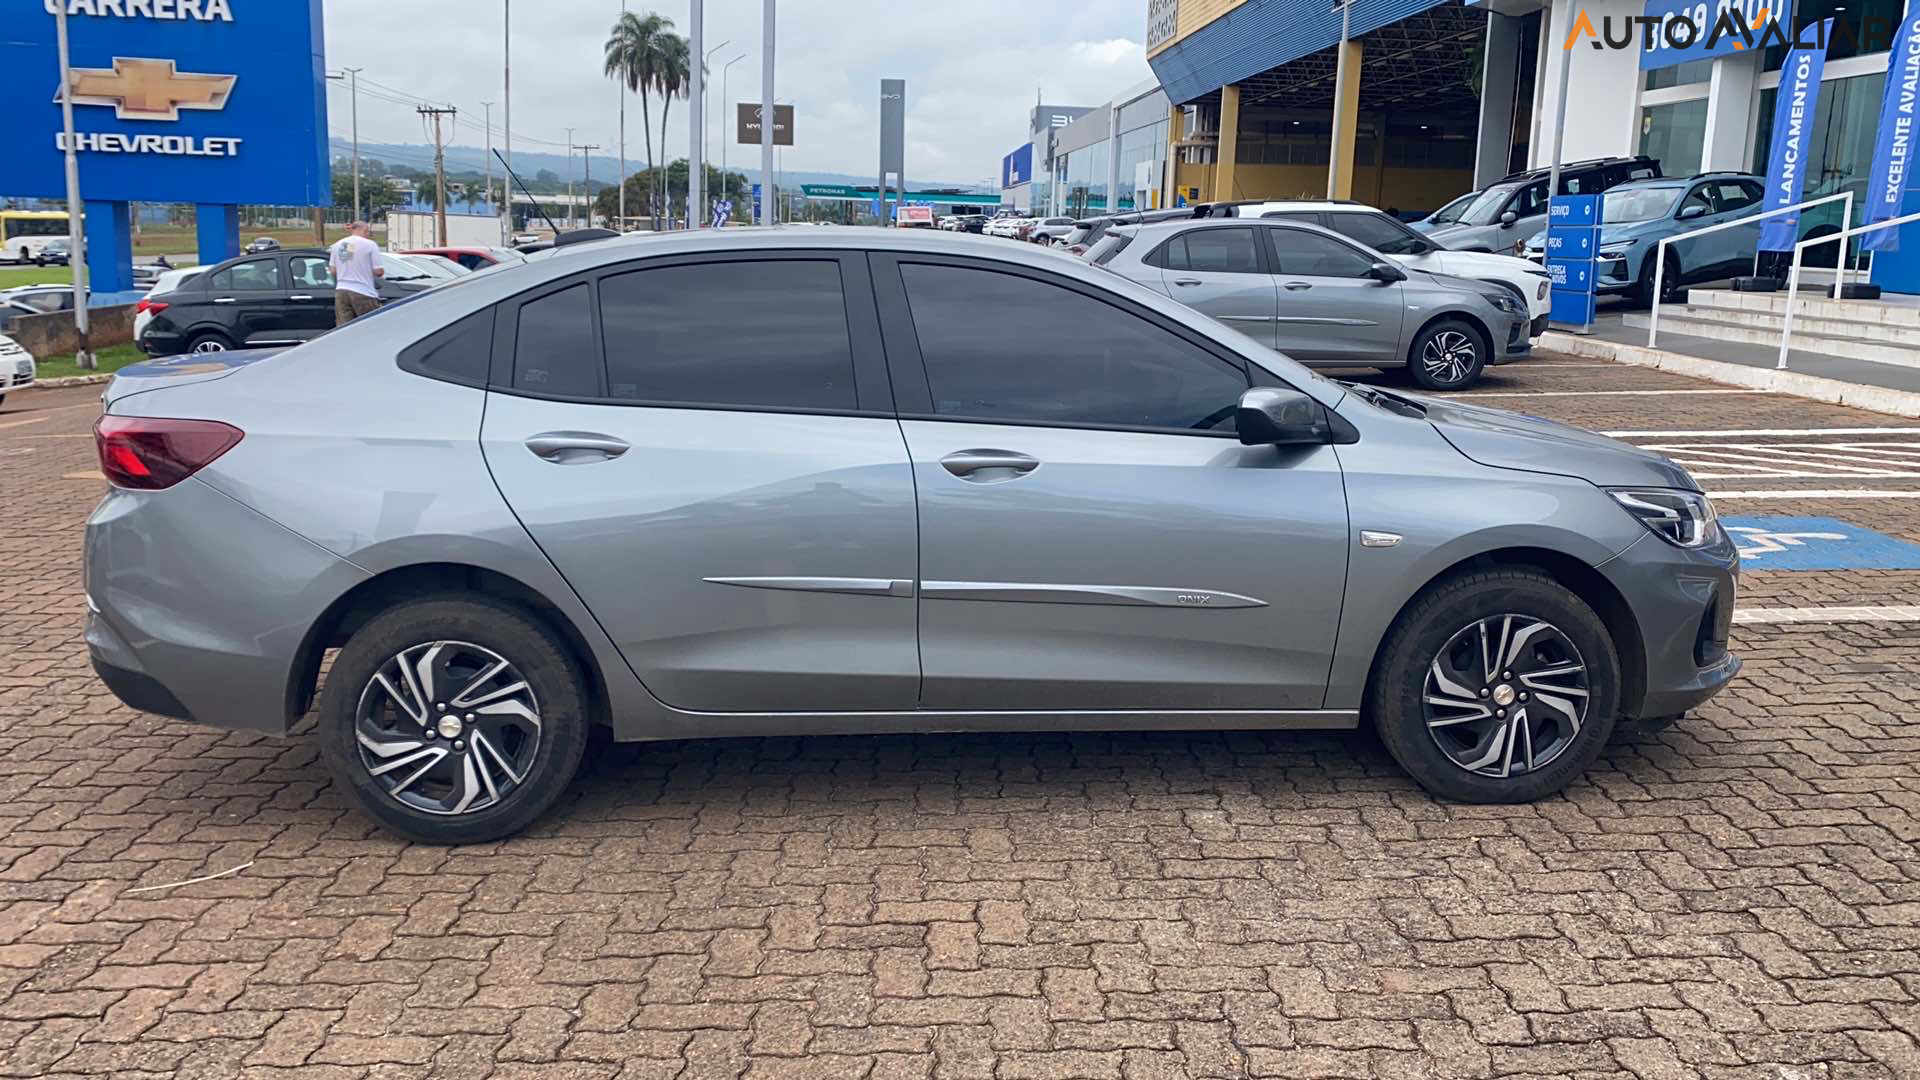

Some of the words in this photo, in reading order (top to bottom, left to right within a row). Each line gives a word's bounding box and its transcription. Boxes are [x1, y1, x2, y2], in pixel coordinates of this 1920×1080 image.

[56, 132, 242, 156] CHEVROLET
[1884, 116, 1912, 203] EXCELENTE
[1177, 595, 1210, 604] ONIX
